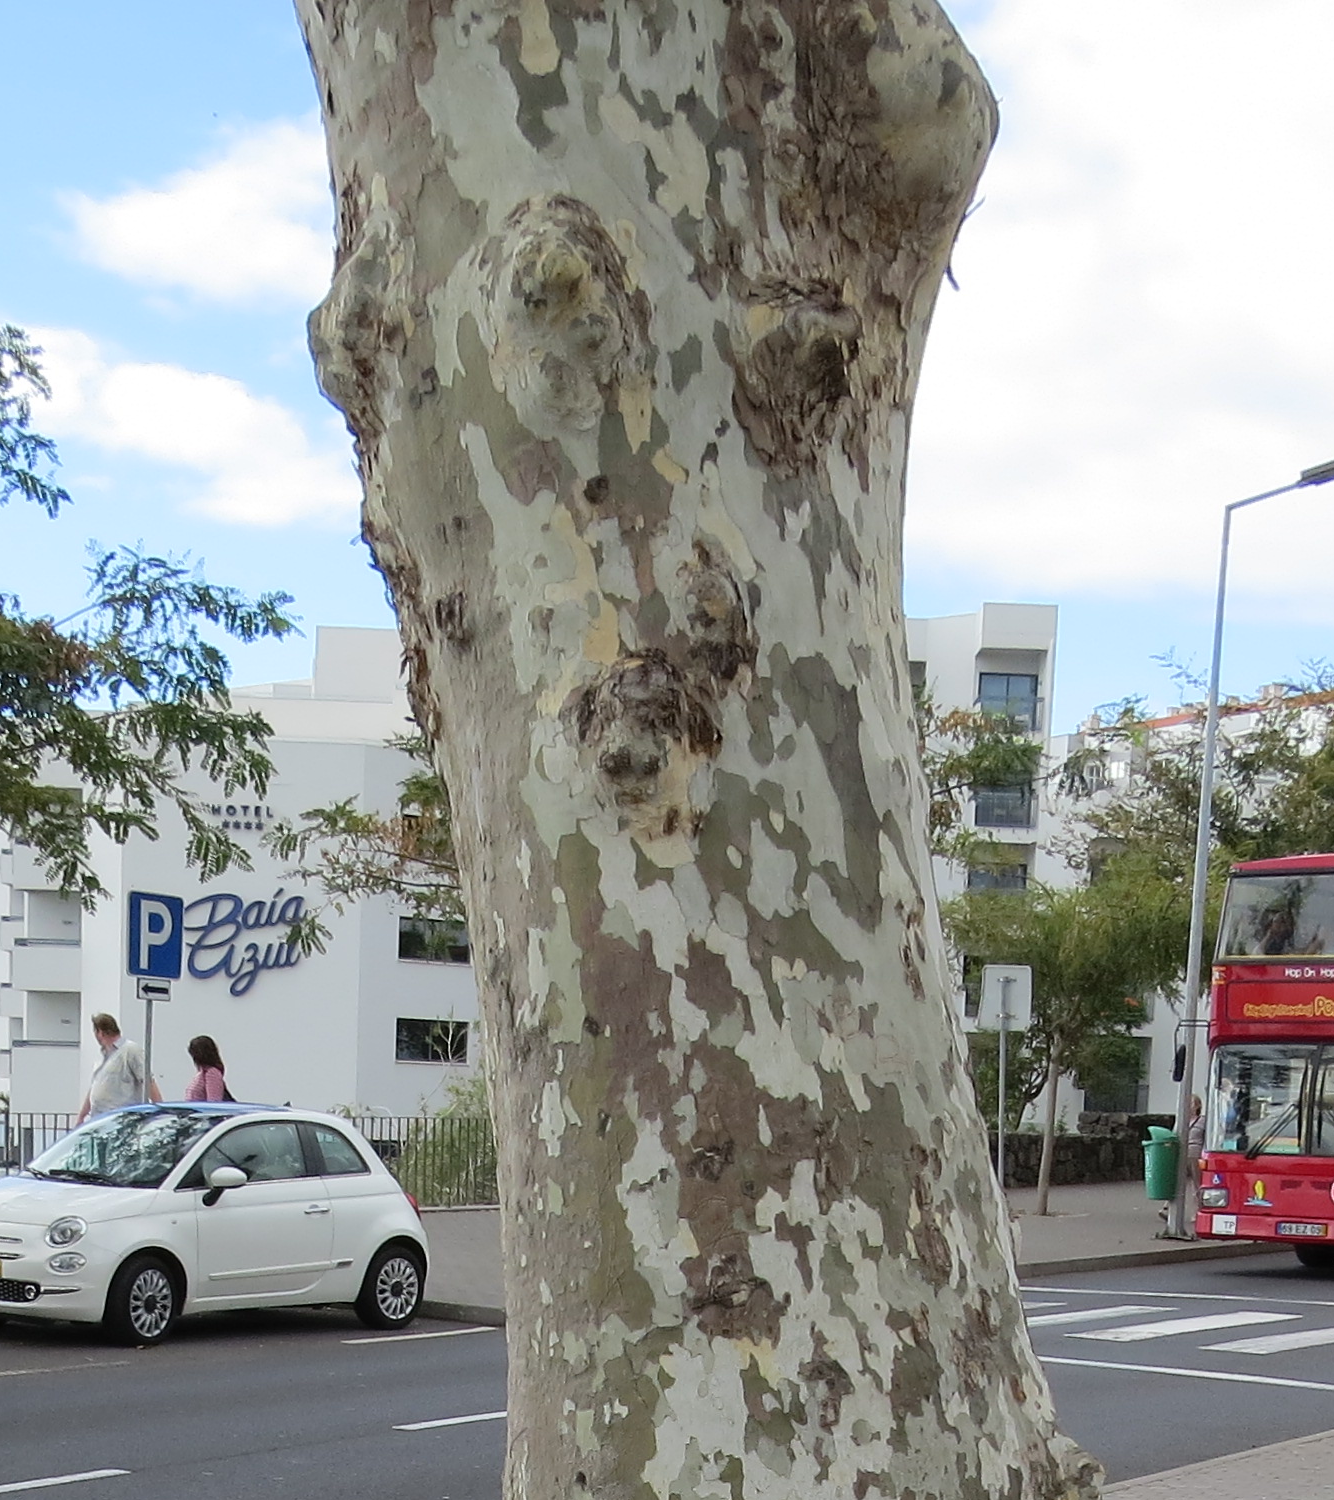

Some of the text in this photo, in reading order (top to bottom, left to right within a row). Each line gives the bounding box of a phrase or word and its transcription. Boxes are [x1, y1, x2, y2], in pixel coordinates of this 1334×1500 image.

[211, 804, 274, 819] HOTEL
[184, 887, 305, 932] Baía
[139, 899, 173, 970] P
[185, 918, 302, 997] Azul
[1284, 967, 1303, 979] Hop
[1303, 967, 1316, 978] On
